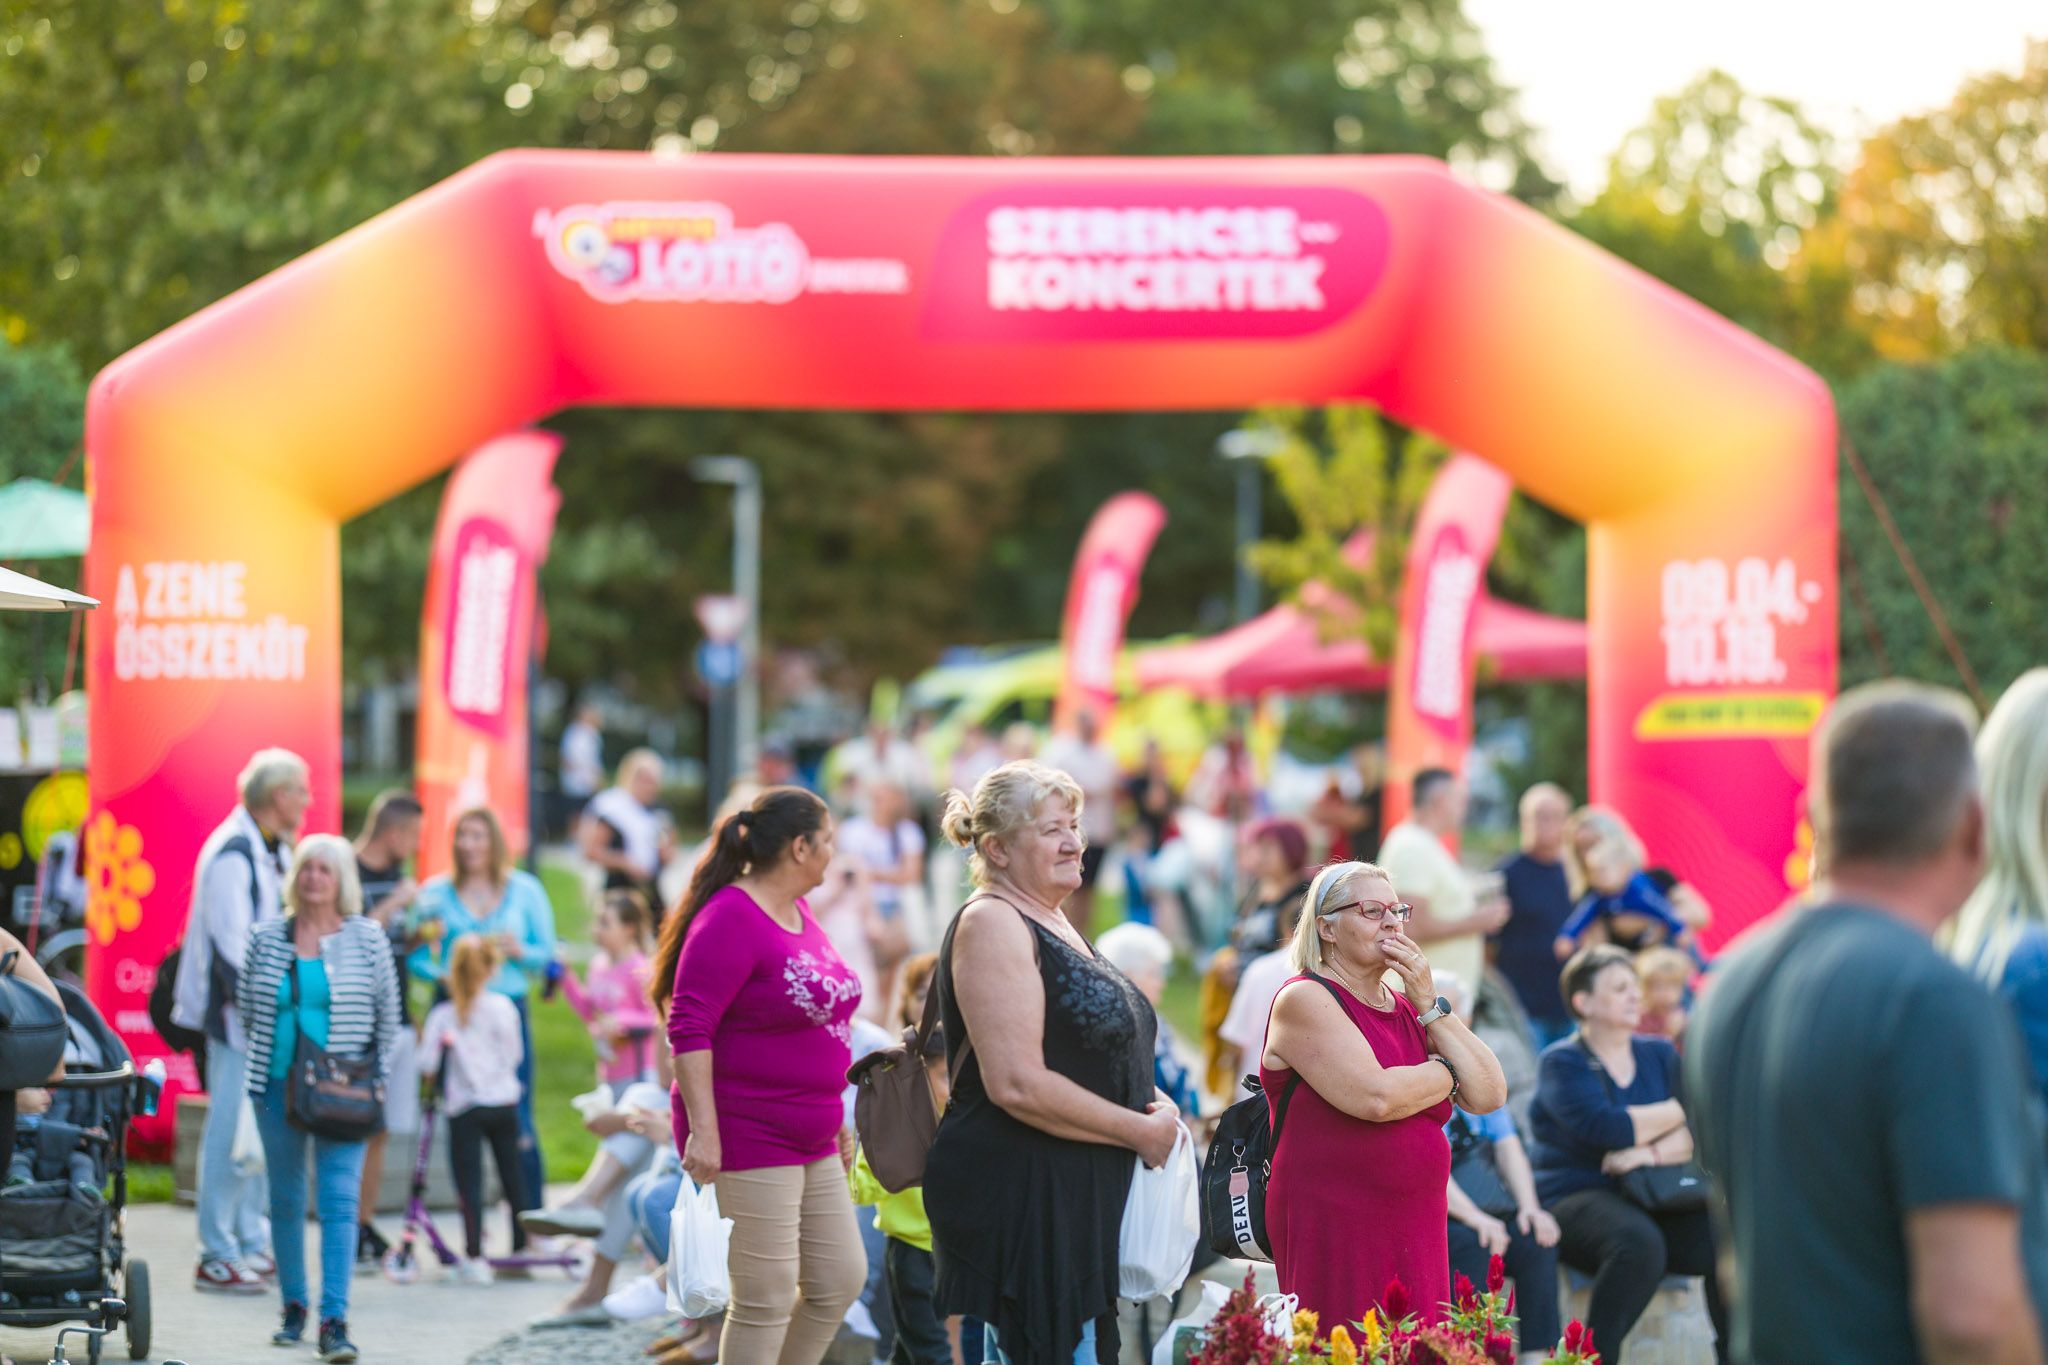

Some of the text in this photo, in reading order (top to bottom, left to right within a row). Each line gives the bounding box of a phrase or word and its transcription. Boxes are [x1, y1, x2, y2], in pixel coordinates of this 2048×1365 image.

[988, 255, 1326, 311] KONCERTEK
[115, 561, 248, 618] A ZENE
[114, 614, 308, 681] ÖSSZEKÖT
[1233, 1196, 1252, 1244] DEAU
